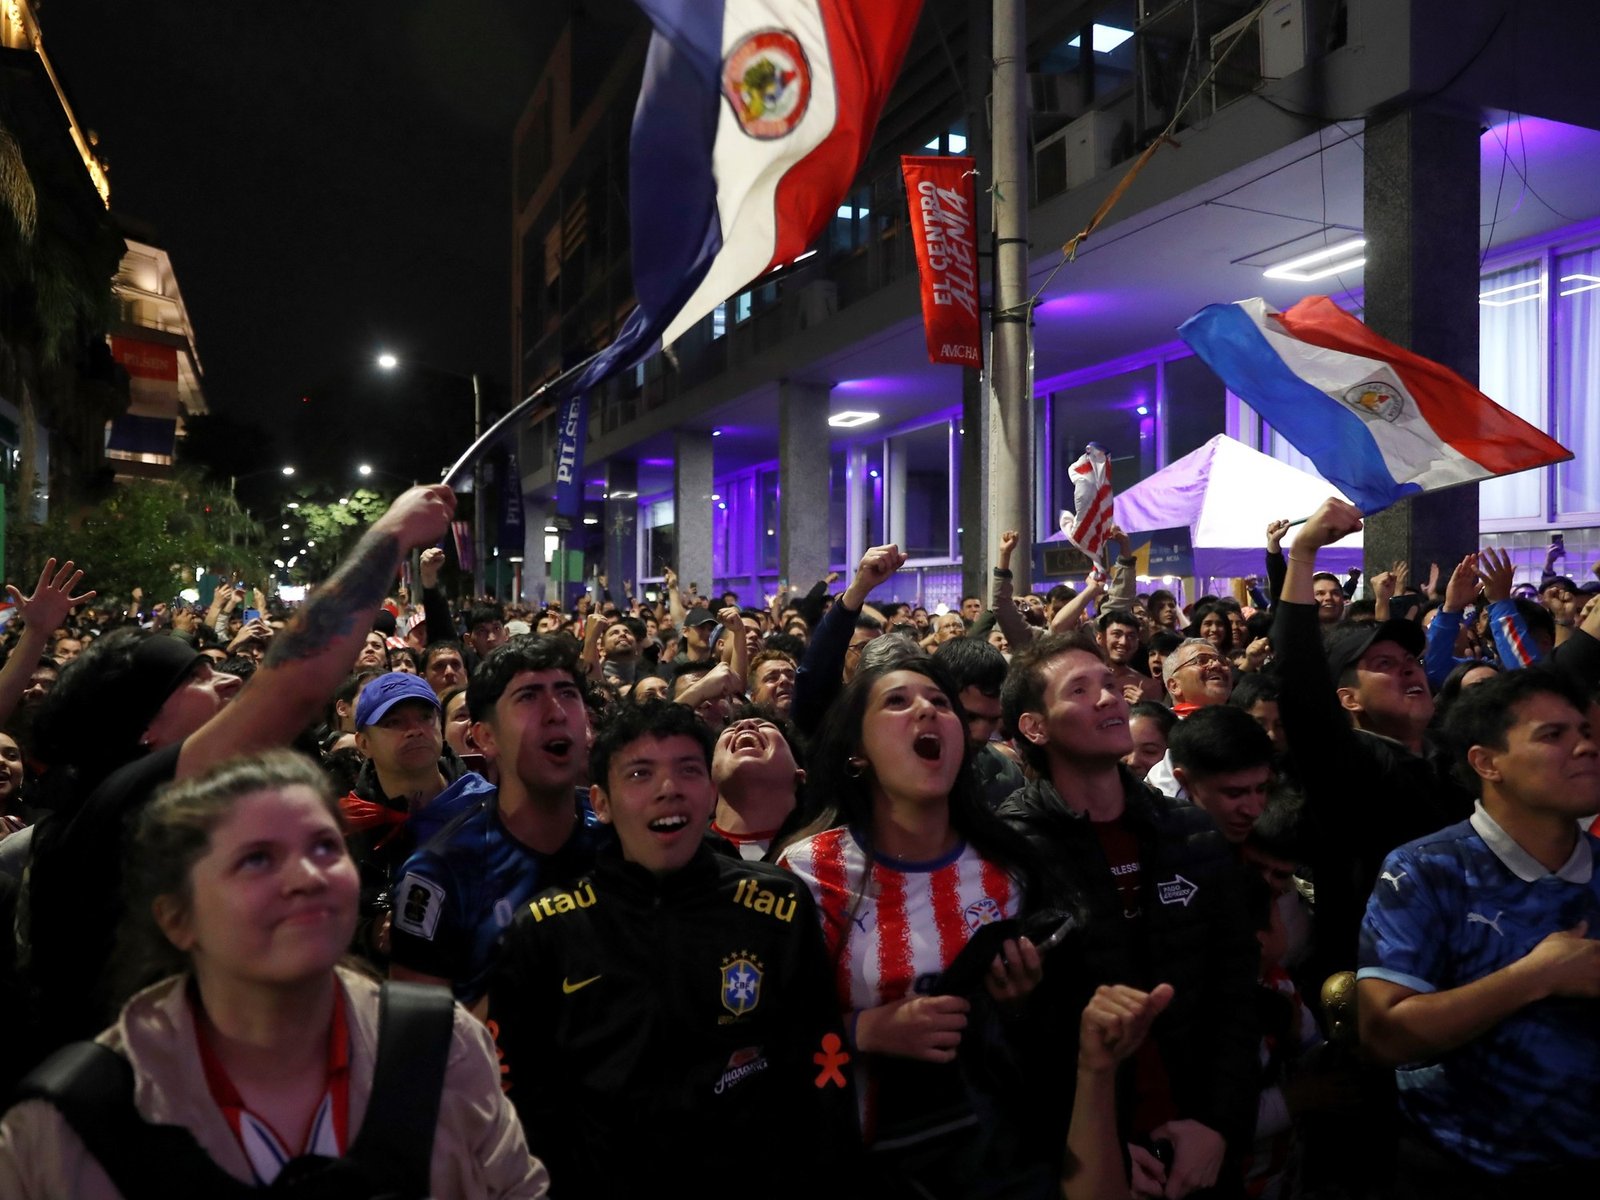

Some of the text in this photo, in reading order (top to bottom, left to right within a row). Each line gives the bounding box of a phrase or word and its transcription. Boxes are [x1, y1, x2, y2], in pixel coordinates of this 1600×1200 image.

[918, 181, 952, 305] EL CENTRO
[940, 343, 979, 361] AMCHA
[529, 880, 597, 923] Itaú
[733, 879, 797, 923] Itaú
[734, 981, 750, 990] CBF
